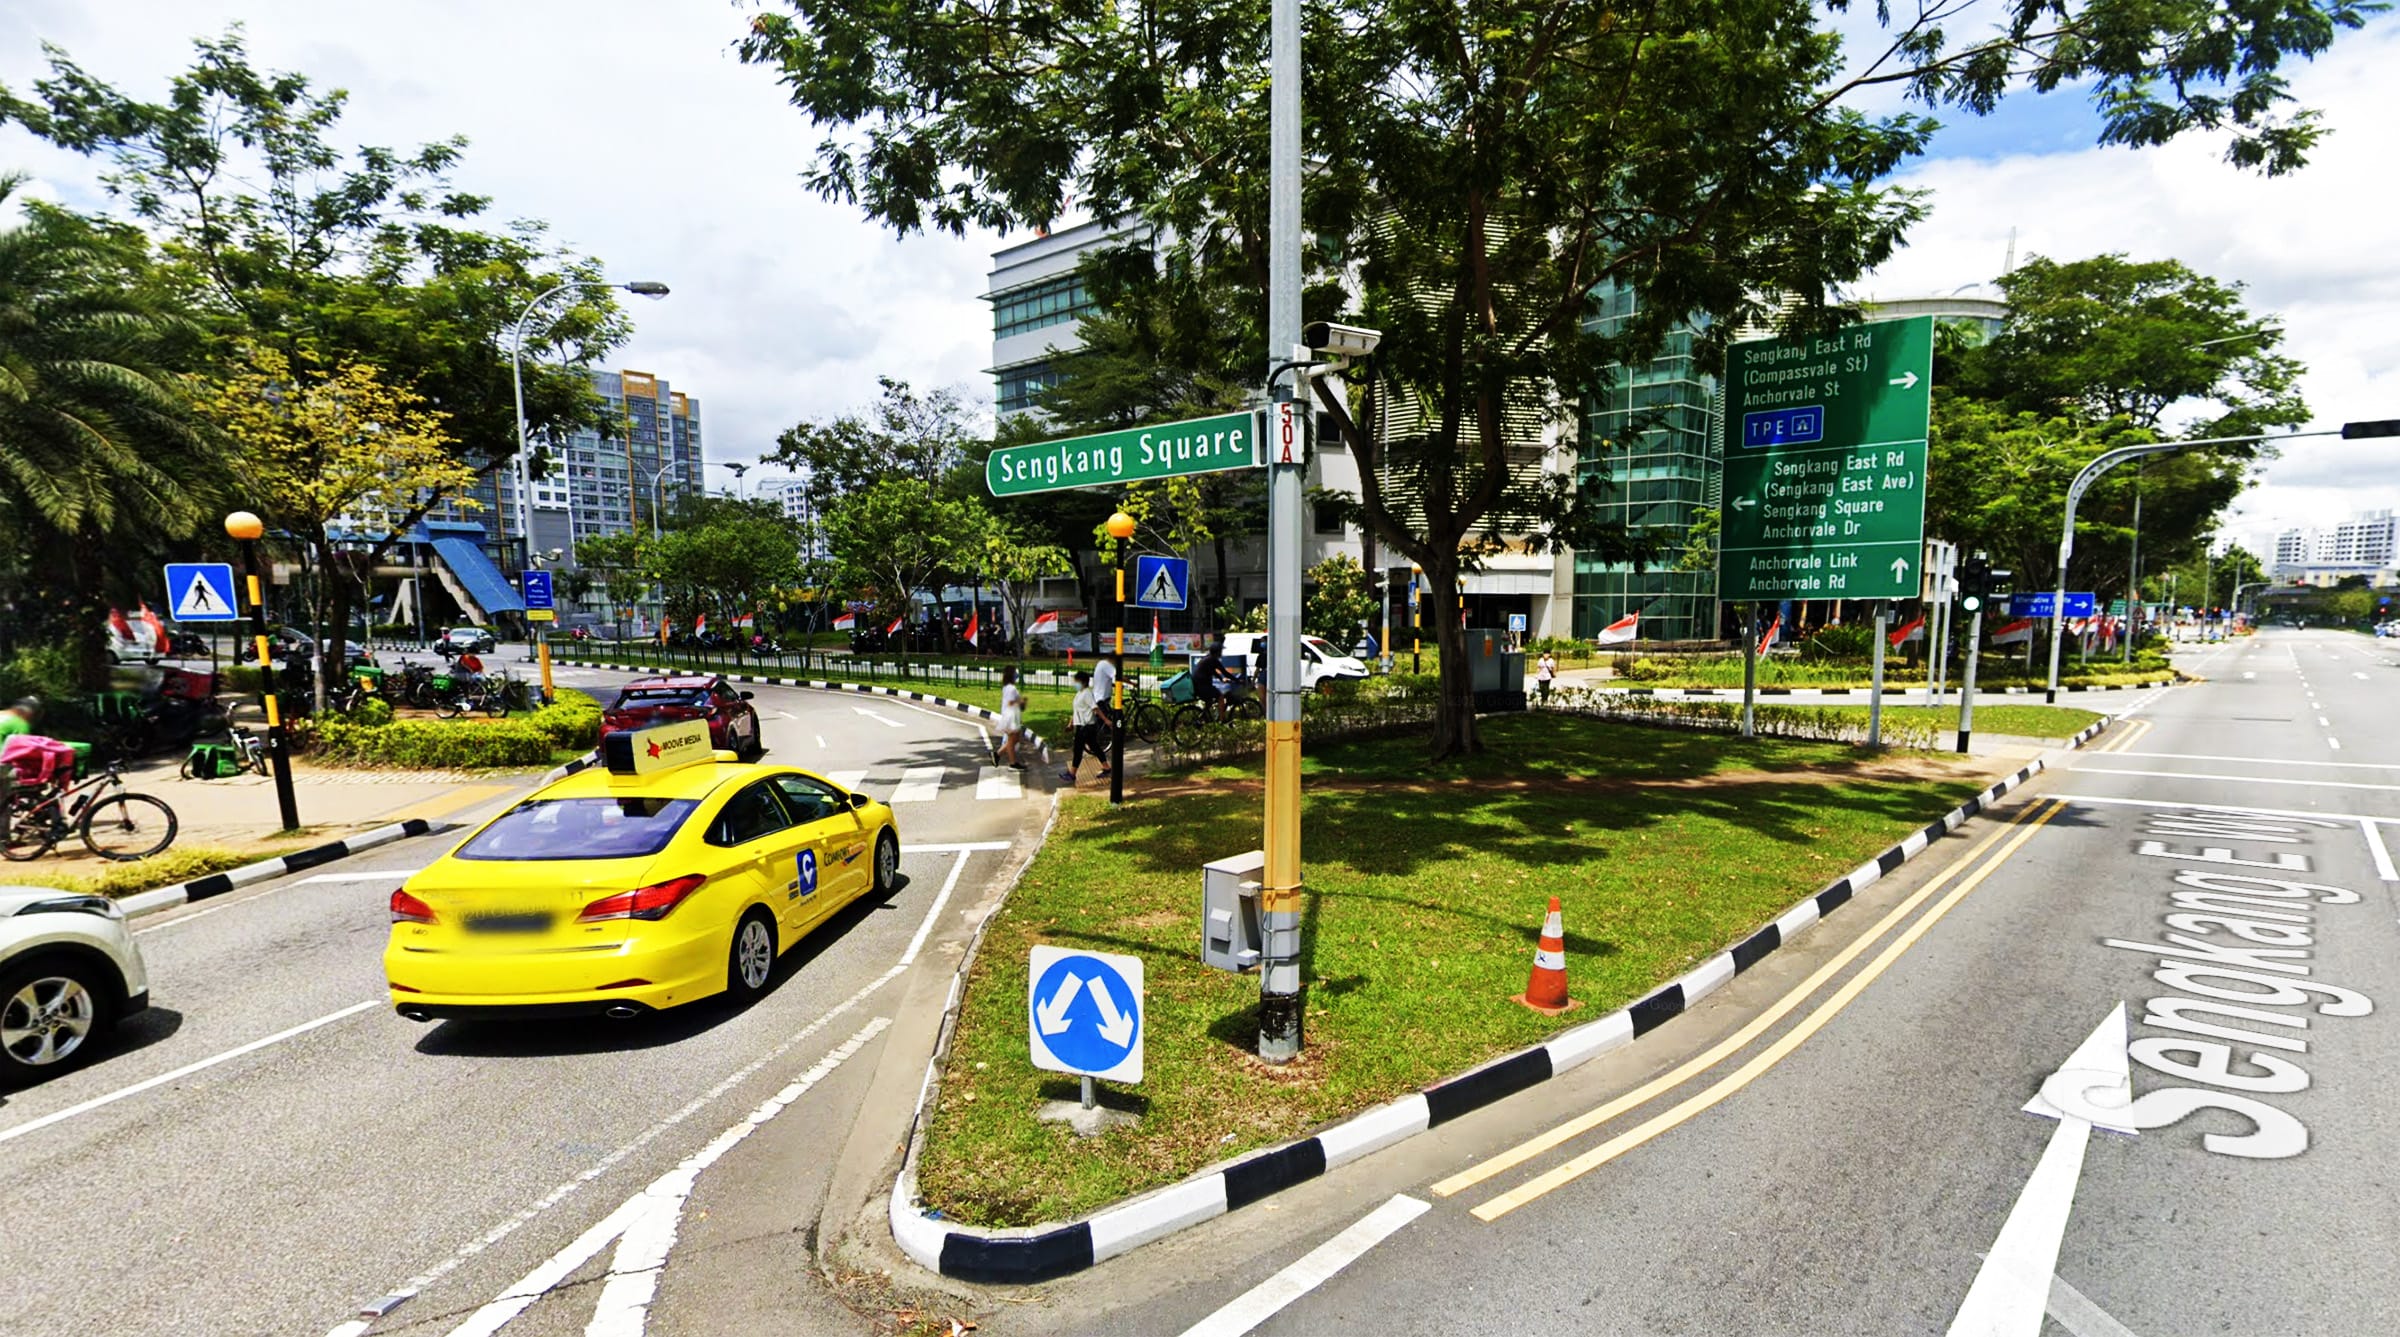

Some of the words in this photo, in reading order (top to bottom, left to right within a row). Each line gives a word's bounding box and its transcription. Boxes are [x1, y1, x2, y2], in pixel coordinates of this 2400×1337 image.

[1816, 340, 1845, 356] East
[1855, 332, 1871, 349] Rd
[1744, 362, 1837, 386] (Compassvale
[1846, 355, 1868, 373] St)
[1744, 384, 1816, 406] Anchorvale
[1824, 382, 1839, 396] St
[1281, 403, 1293, 463] 50A
[1752, 420, 1784, 437] TPE
[1000, 446, 1123, 484] Sengkang
[1139, 428, 1244, 469] Square
[1774, 459, 1838, 476] Sengkang
[1847, 455, 1878, 471] East
[1886, 451, 1904, 467] Rd
[1764, 480, 1834, 498] (Sengkang
[1842, 476, 1872, 492] East
[1882, 472, 1914, 490] Ave)
[1764, 501, 1826, 518] Sengkang
[1835, 499, 1884, 517] Square
[1763, 522, 1836, 538] Anchorvale
[1845, 520, 1860, 535] Dr
[1750, 556, 1821, 570] Anchorvale
[1830, 553, 1858, 568] Link
[1750, 577, 1820, 591] Anchorvale
[1829, 575, 1845, 589] Rd
